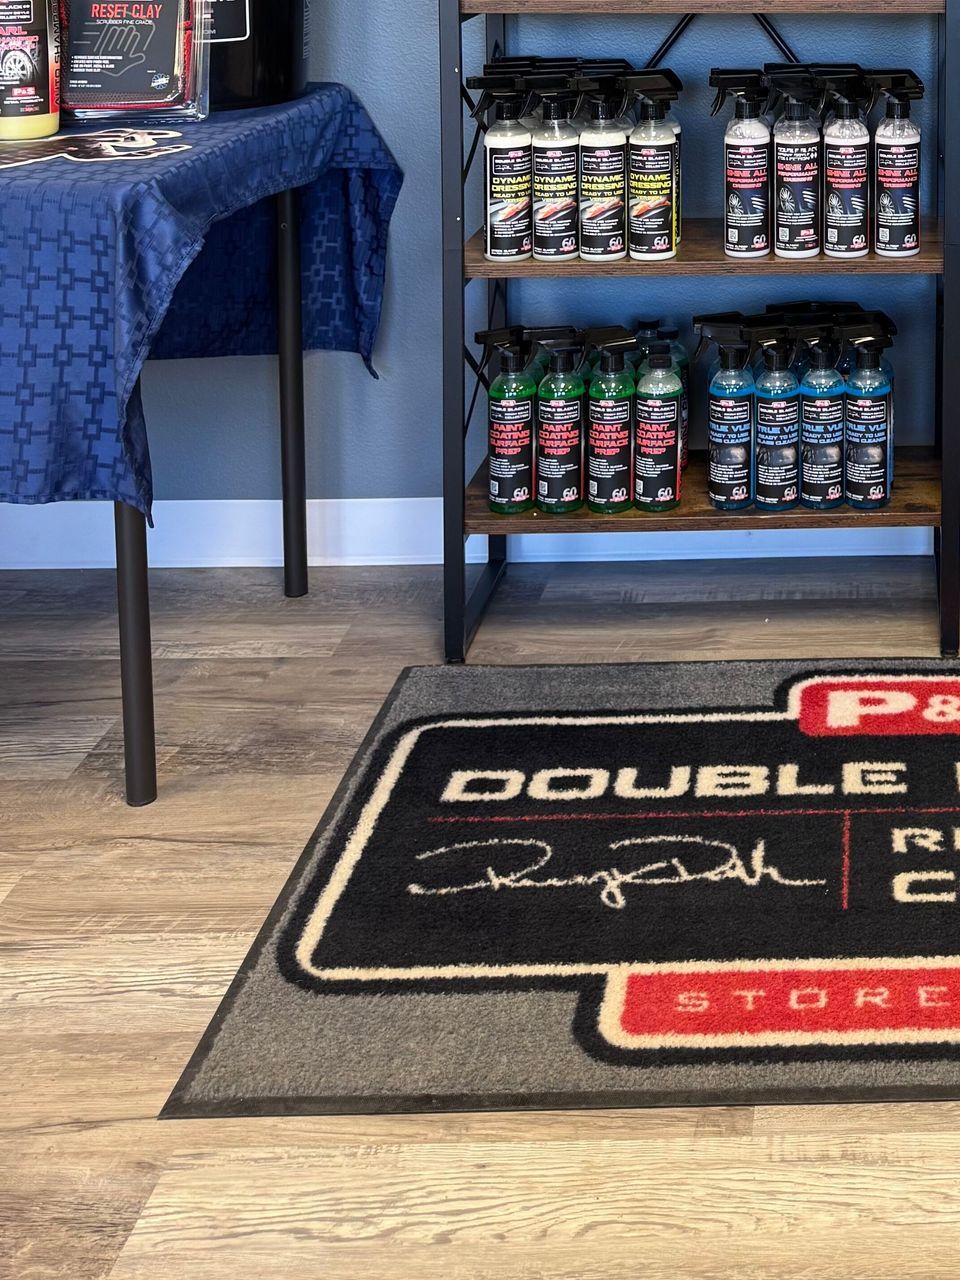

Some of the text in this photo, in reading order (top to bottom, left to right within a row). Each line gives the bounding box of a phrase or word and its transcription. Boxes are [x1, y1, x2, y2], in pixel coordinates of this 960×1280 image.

[91, 3, 162, 19] RESET CLAY
[13, 87, 36, 95] P&S
[753, 169, 767, 177] ALL
[534, 174, 576, 183] DYNAMIC
[581, 174, 624, 183] DYNAMIC
[533, 181, 577, 191] DRESSING
[581, 181, 624, 190] DRESSING
[493, 422, 525, 432] PAINT
[757, 422, 798, 434] TRUE VUE
[490, 429, 530, 440] COATING
[495, 447, 521, 455] PREP
[440, 761, 908, 804] DOUBLE
[674, 983, 955, 1014] STORE
